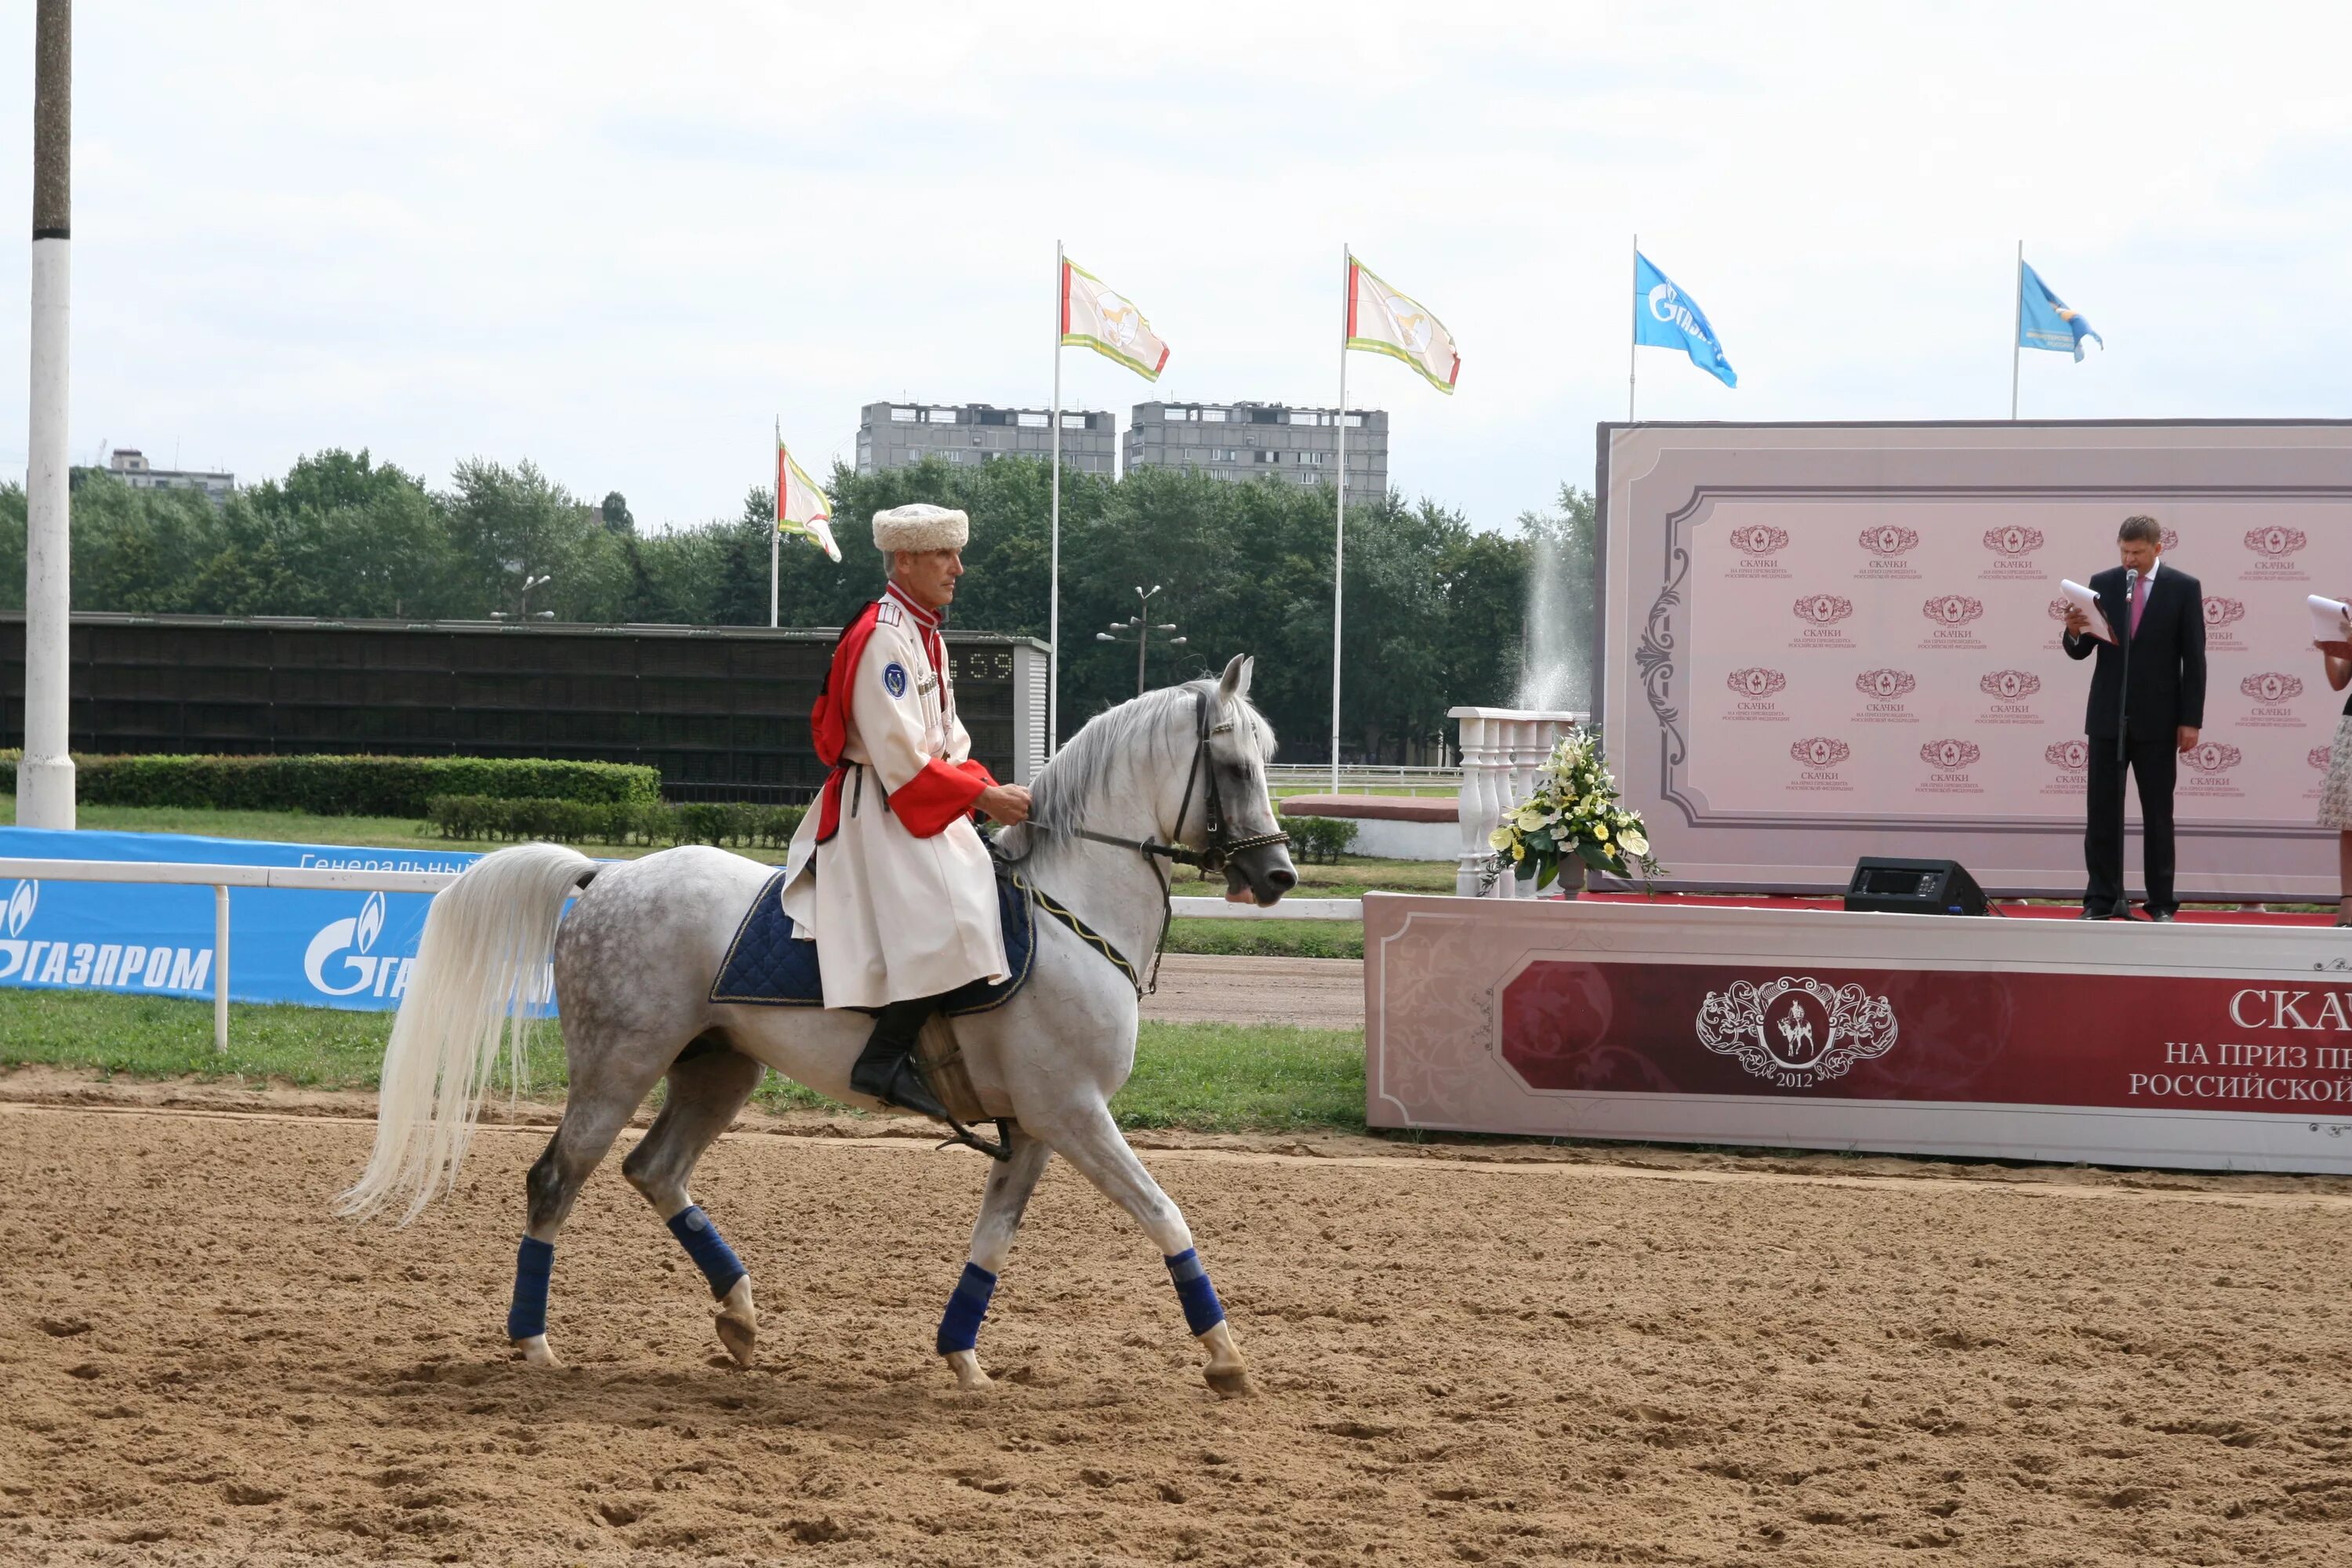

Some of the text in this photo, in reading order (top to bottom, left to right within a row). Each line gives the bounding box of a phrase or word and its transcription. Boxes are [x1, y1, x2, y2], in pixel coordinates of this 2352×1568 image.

[22, 940, 213, 990] ГАЗПРОМ
[2229, 989, 2352, 1031] СКА
[2164, 1042, 2210, 1065] НА
[2217, 1044, 2307, 1069] ПРИЗ
[1776, 1072, 1813, 1087] 2012
